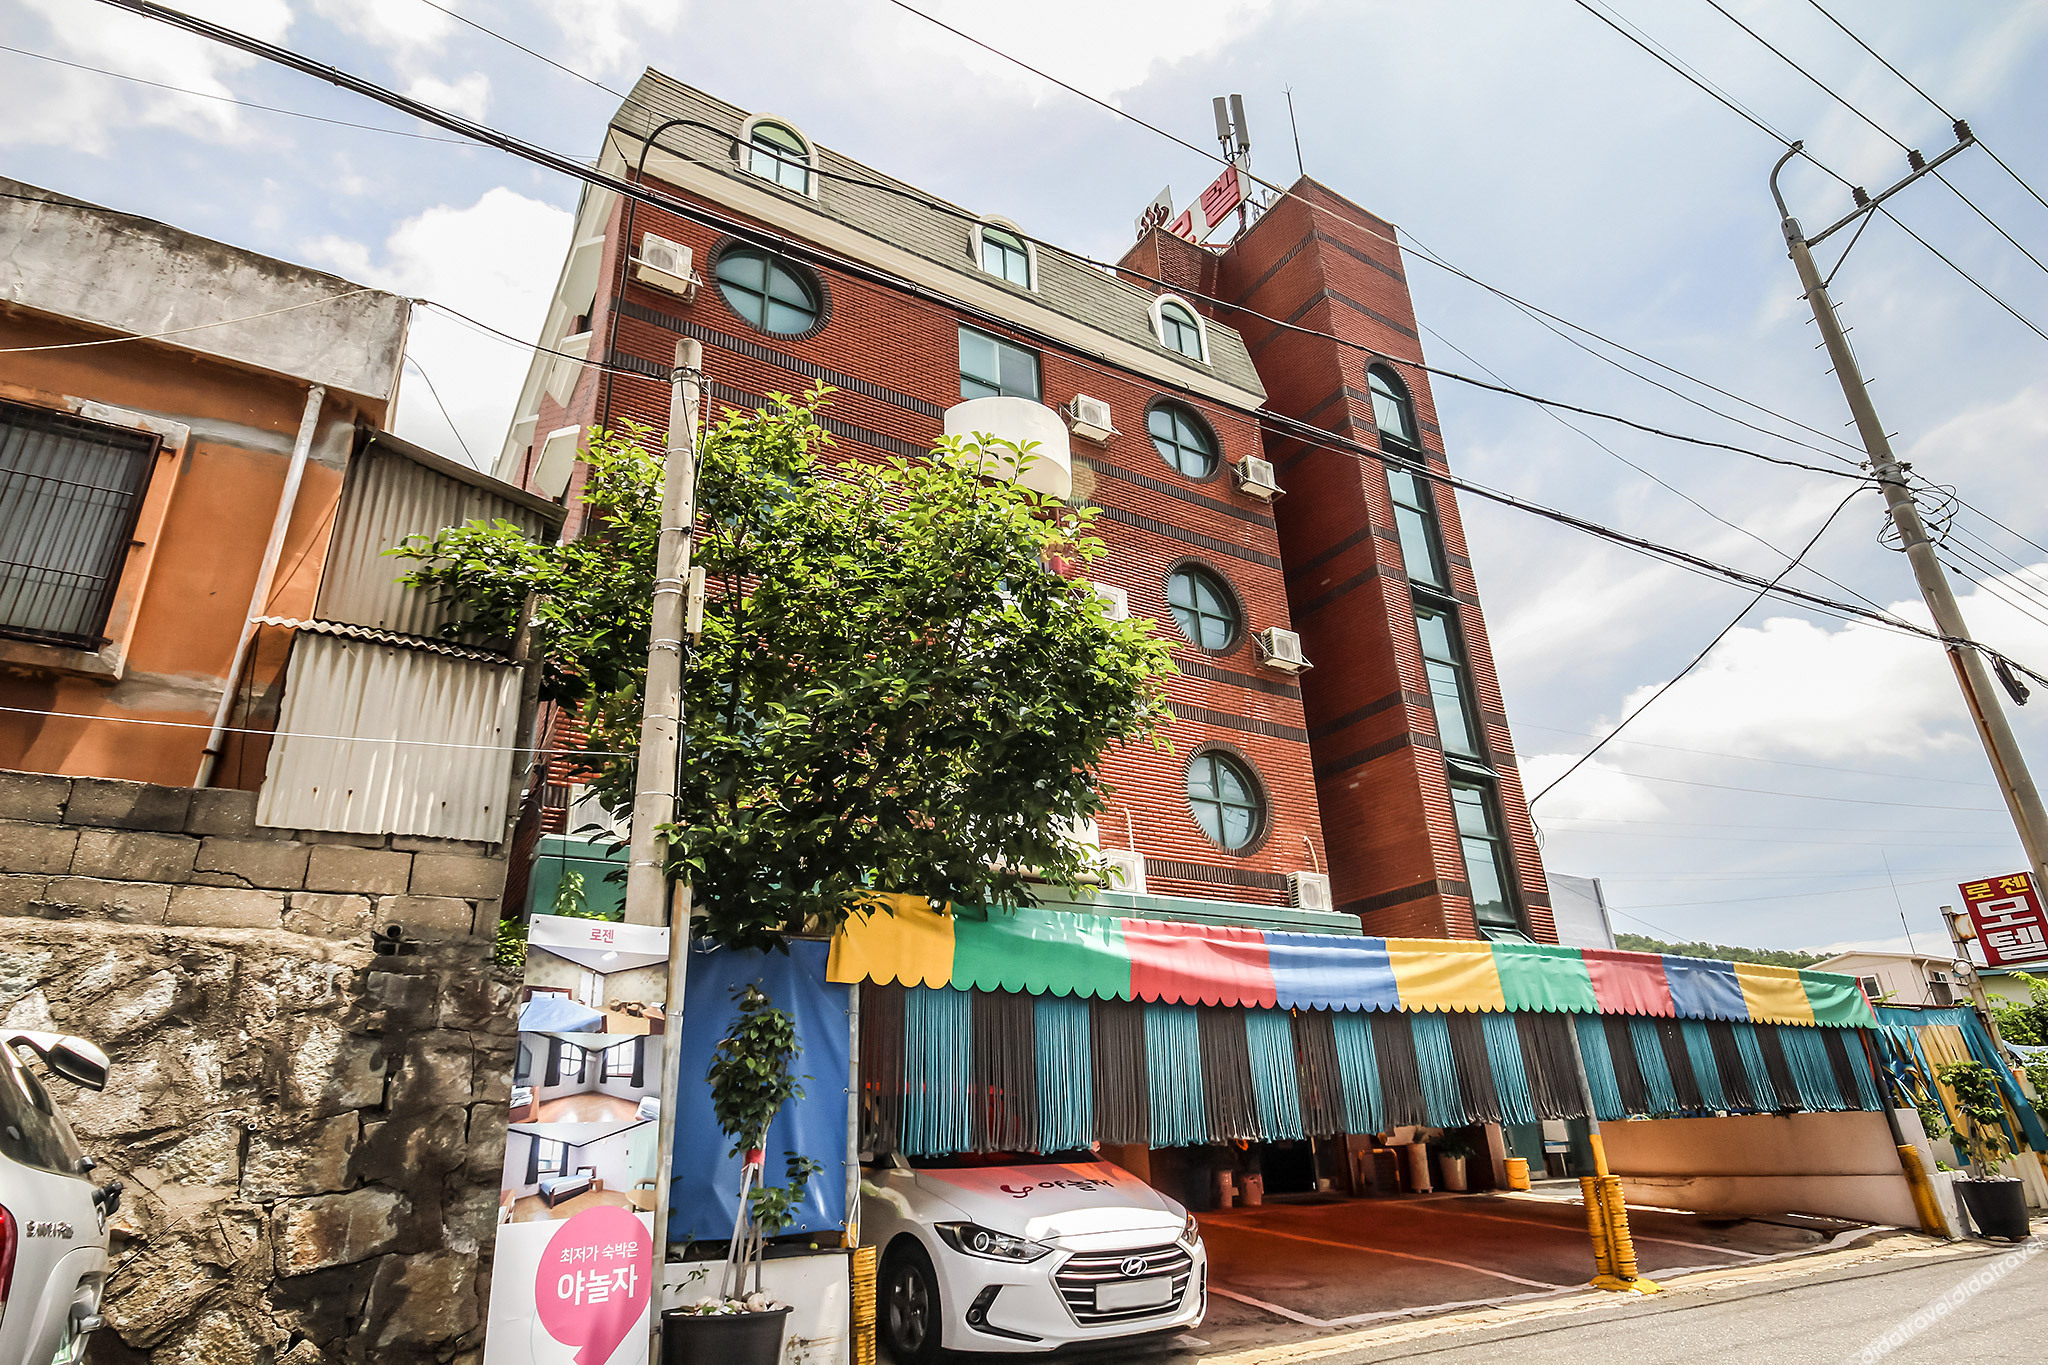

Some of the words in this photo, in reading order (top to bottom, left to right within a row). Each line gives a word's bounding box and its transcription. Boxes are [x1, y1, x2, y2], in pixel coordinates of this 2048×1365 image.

[589, 927, 615, 944] 로젠
[1976, 895, 2048, 961] 모텔
[1037, 1179, 1114, 1192] 야놀자
[560, 1244, 599, 1264] 최저가
[602, 1241, 639, 1260] 숙박은
[557, 1263, 639, 1306] 야놀자
